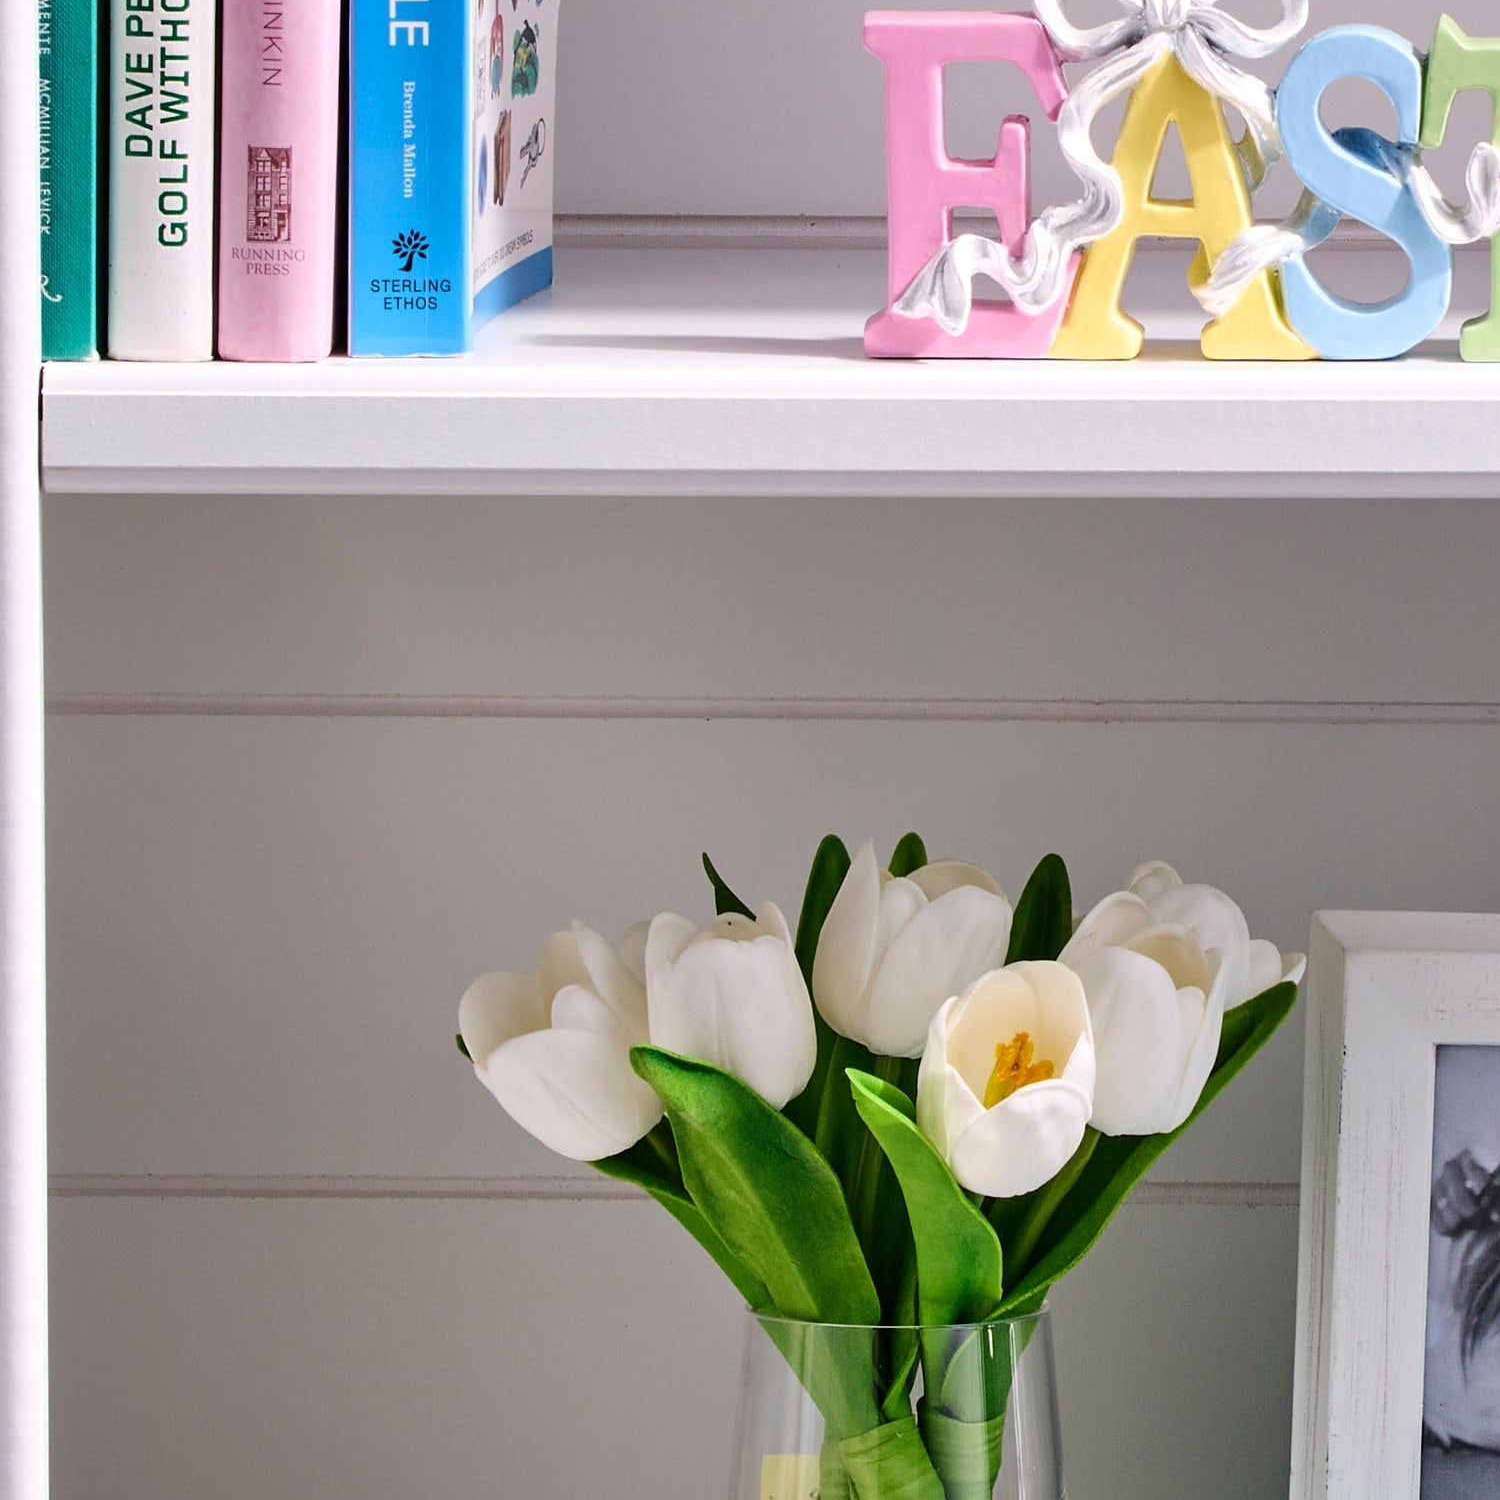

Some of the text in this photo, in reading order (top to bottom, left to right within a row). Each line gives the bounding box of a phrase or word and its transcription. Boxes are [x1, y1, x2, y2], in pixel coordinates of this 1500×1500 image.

[125, 52, 153, 158] DAVE
[403, 80, 416, 198] Brenda Mallon
[158, 139, 188, 247] GOLF
[231, 247, 306, 262] RUNNING
[246, 263, 291, 276] PRESS
[370, 279, 451, 293] STERLING
[383, 297, 438, 310] ETHOS
